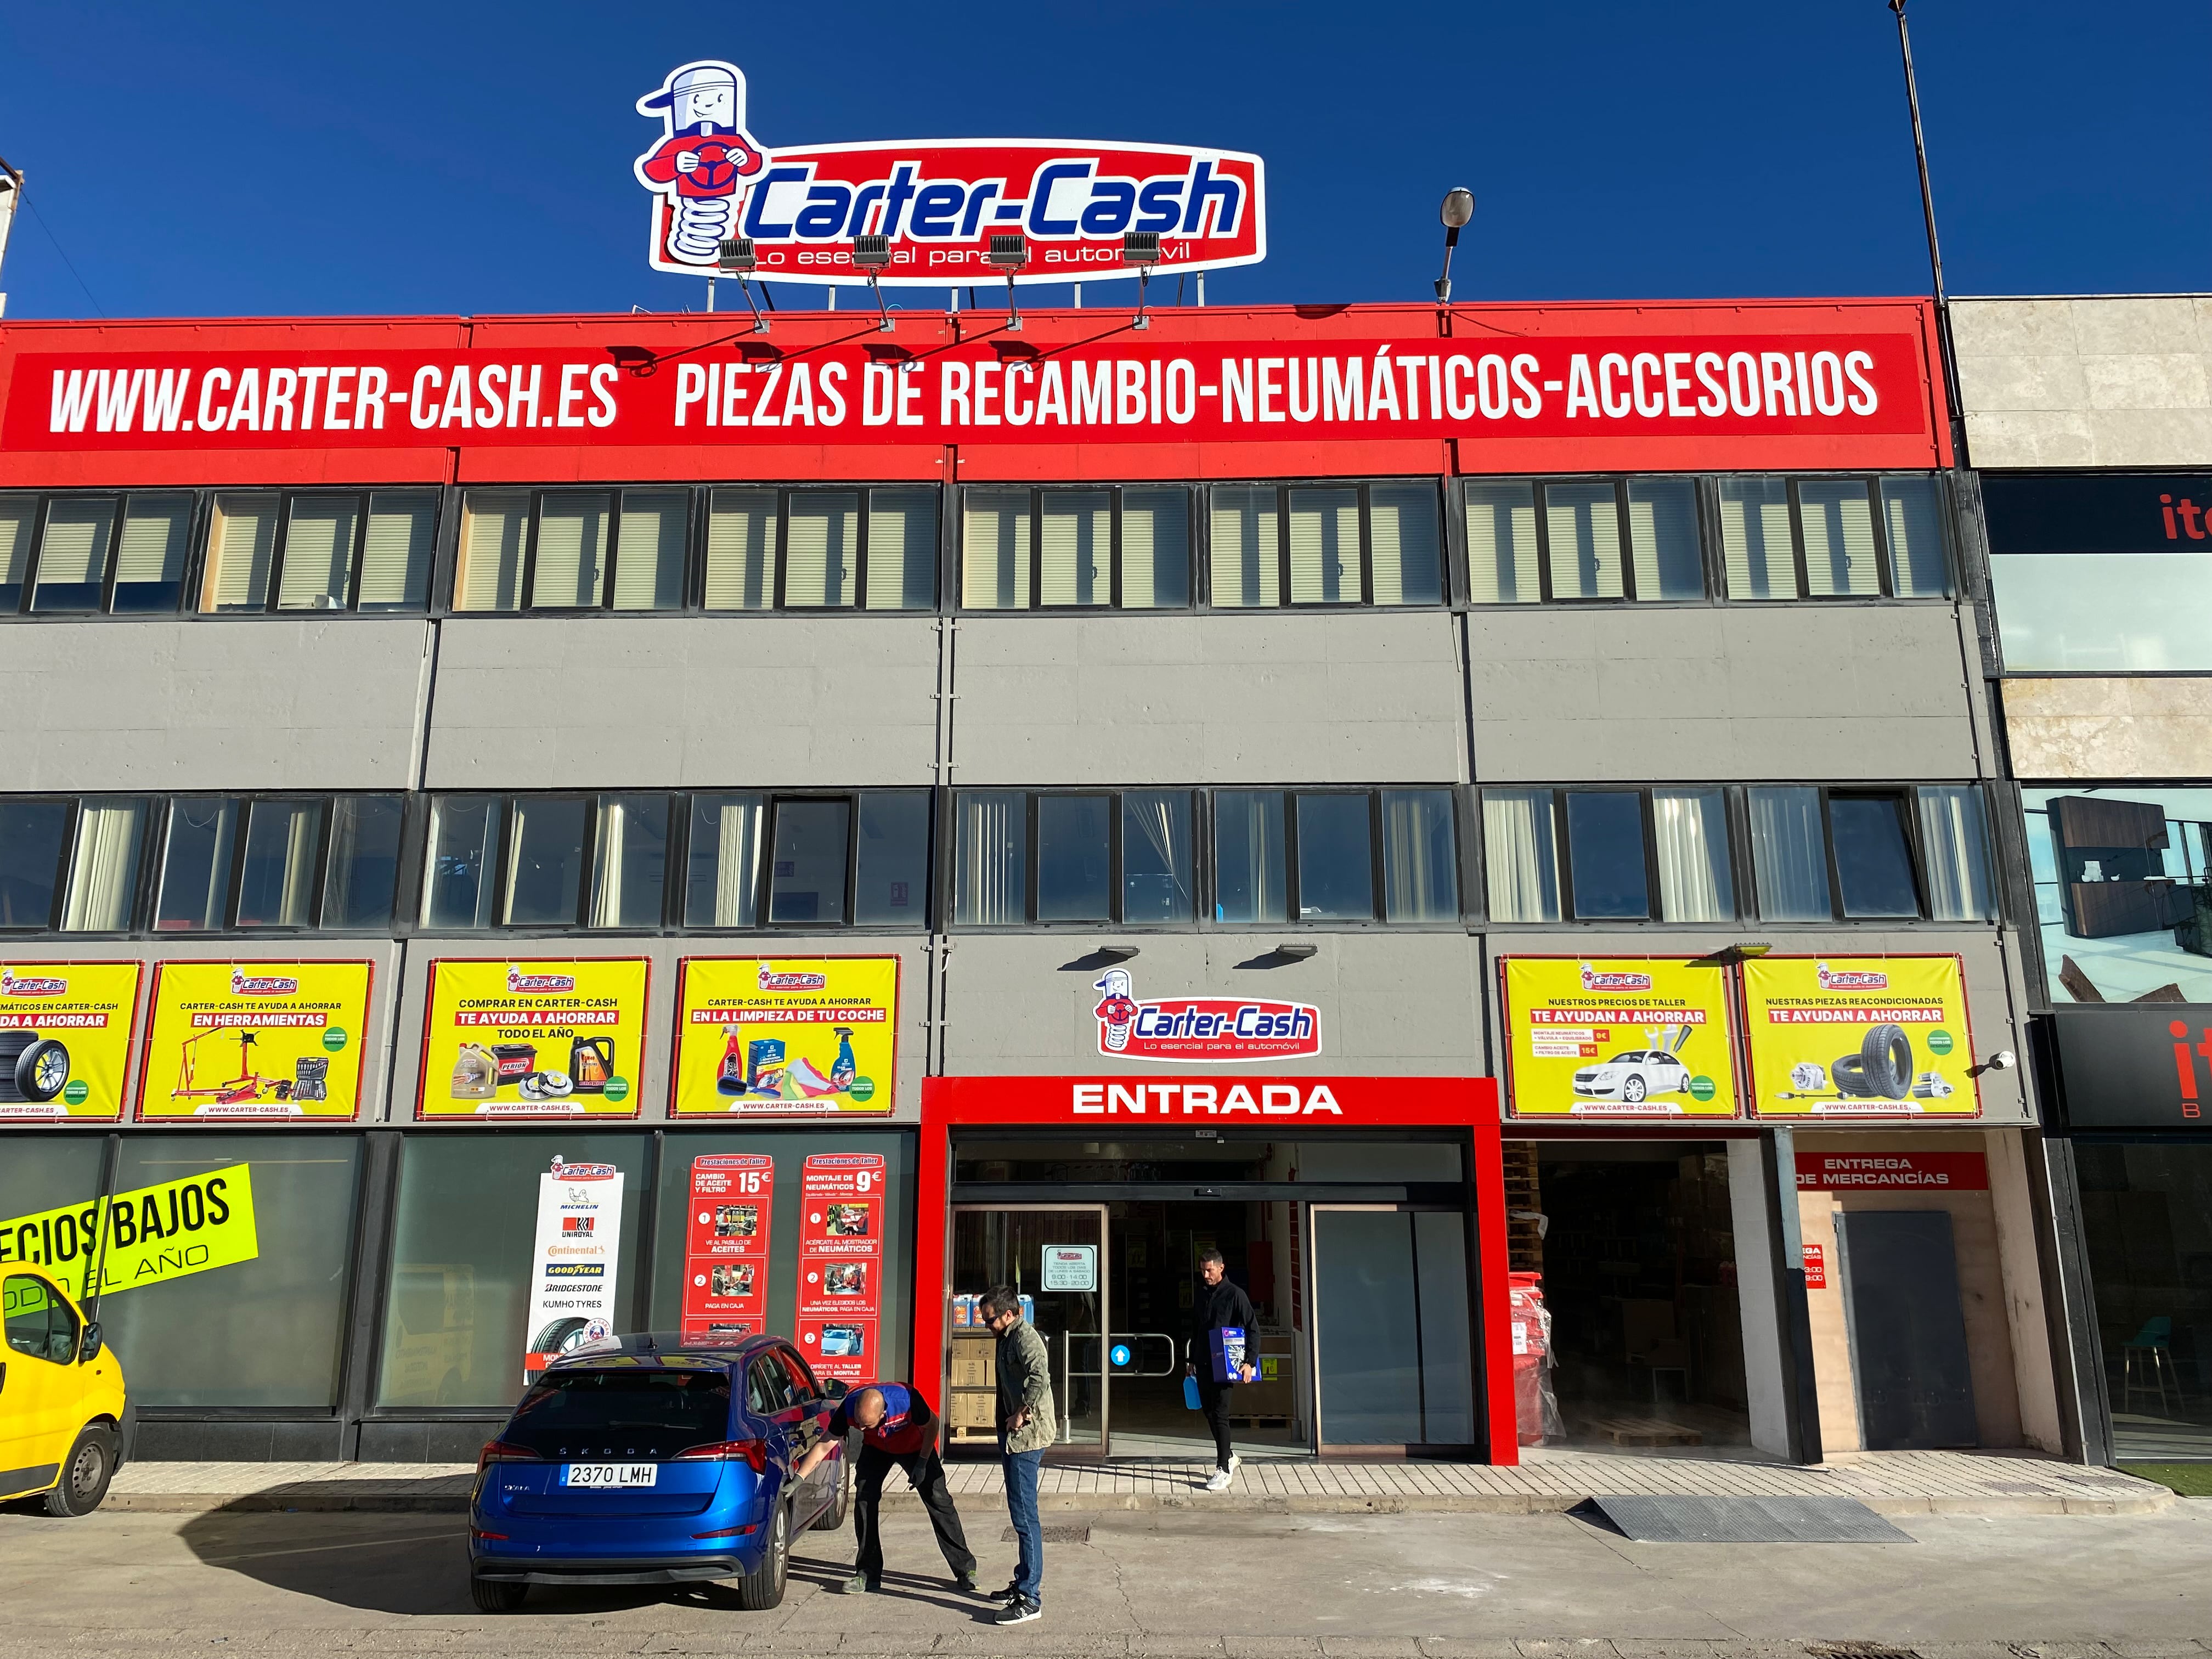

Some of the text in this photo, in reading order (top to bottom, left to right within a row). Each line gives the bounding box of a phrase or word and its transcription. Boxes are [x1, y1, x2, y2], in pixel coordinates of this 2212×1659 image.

[743, 161, 1242, 238] Carter-Cash
[797, 246, 916, 265] eseal
[1045, 241, 1190, 263] autovil
[49, 363, 619, 433] WWW.CARTER-CASH.ES
[674, 362, 848, 427] PIEZAS
[862, 362, 924, 426] DE
[242, 979, 296, 989] Carter-Cash
[518, 977, 572, 988] Carter-Cash
[769, 974, 823, 985] Carter-Cash
[1594, 975, 1649, 985] Carter-Cash
[1831, 974, 1885, 984] Carter-Cash
[13, 980, 65, 990] Carter-Cash
[0, 1002, 41, 1011] MÁTICOS
[459, 998, 618, 1008] COMPRAR EN CARTER-CASH
[1548, 998, 1597, 1006] NUESTROS
[21, 1015, 33, 1026] A
[35, 1015, 105, 1026] AHORRAR
[193, 1014, 325, 1026] EN HERRAMIENTAS
[459, 1012, 616, 1024] TE AYUDA A AHORRAR
[692, 1009, 884, 1022] EN LA LIMPIEZA DE TU COCHE
[1532, 1011, 1705, 1022] TE AYUDAN A AHORRAR
[1770, 1009, 1942, 1022] TE AYUDAN A AHORRAR
[1136, 1008, 1311, 1037] Carter-Cash
[497, 1026, 574, 1038] TODO EL AÑO
[1143, 1041, 1300, 1052] Lo esencial para el automóvil
[1073, 1084, 1344, 1114] ENTRADA
[1824, 1159, 1912, 1169] ENTREGA
[562, 1166, 613, 1176] Carter-Cash
[738, 1171, 771, 1193] 15€
[856, 1171, 882, 1192] 9€
[1795, 1170, 1949, 1184] DE MERCANCÍAS
[111, 1177, 230, 1249] BAJOS
[548, 1245, 597, 1257] Continental
[818, 1244, 873, 1252] NEUMÁTICOS
[134, 1244, 209, 1279] AÑO
[548, 1266, 602, 1274] GOODYEAR
[544, 1283, 603, 1292] BRIDGESTONE
[543, 1300, 602, 1308] KUMHO TYRES
[571, 1467, 652, 1483] 2370 LMH
